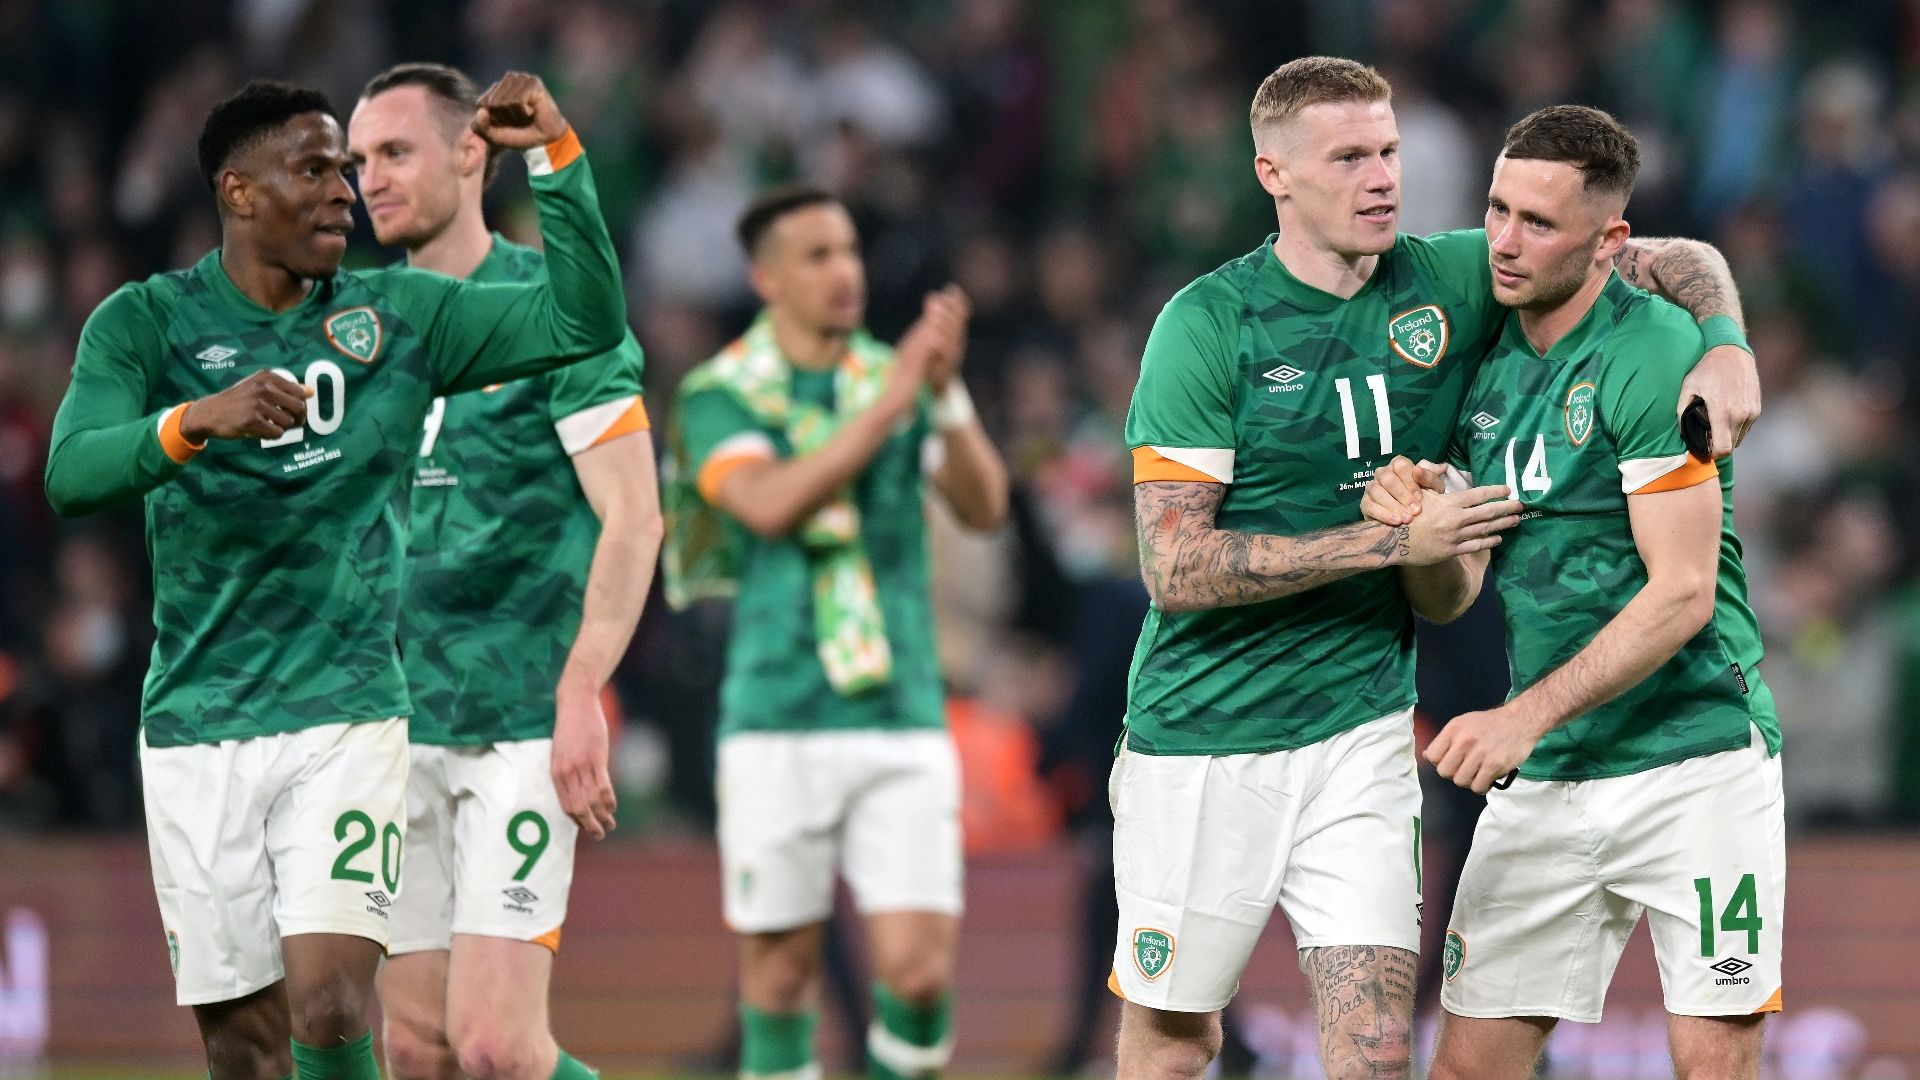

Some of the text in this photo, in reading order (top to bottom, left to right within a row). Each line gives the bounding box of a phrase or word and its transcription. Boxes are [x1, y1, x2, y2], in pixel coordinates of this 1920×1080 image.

[1395, 312, 1432, 335] Ireland
[201, 359, 235, 371] umbro
[1268, 382, 1304, 394] umbro
[1334, 373, 1393, 460] 11
[1473, 430, 1496, 441] umbro
[293, 446, 325, 461] BELGIUM
[298, 455, 324, 469] MARCH
[1504, 433, 1553, 501] 14
[331, 809, 402, 895] 20
[506, 809, 550, 882] 9
[366, 904, 389, 920] umbro
[502, 902, 534, 916] umbro
[1693, 873, 1763, 958] 14
[1141, 933, 1166, 948] Ireland
[1715, 976, 1750, 986] umbro
